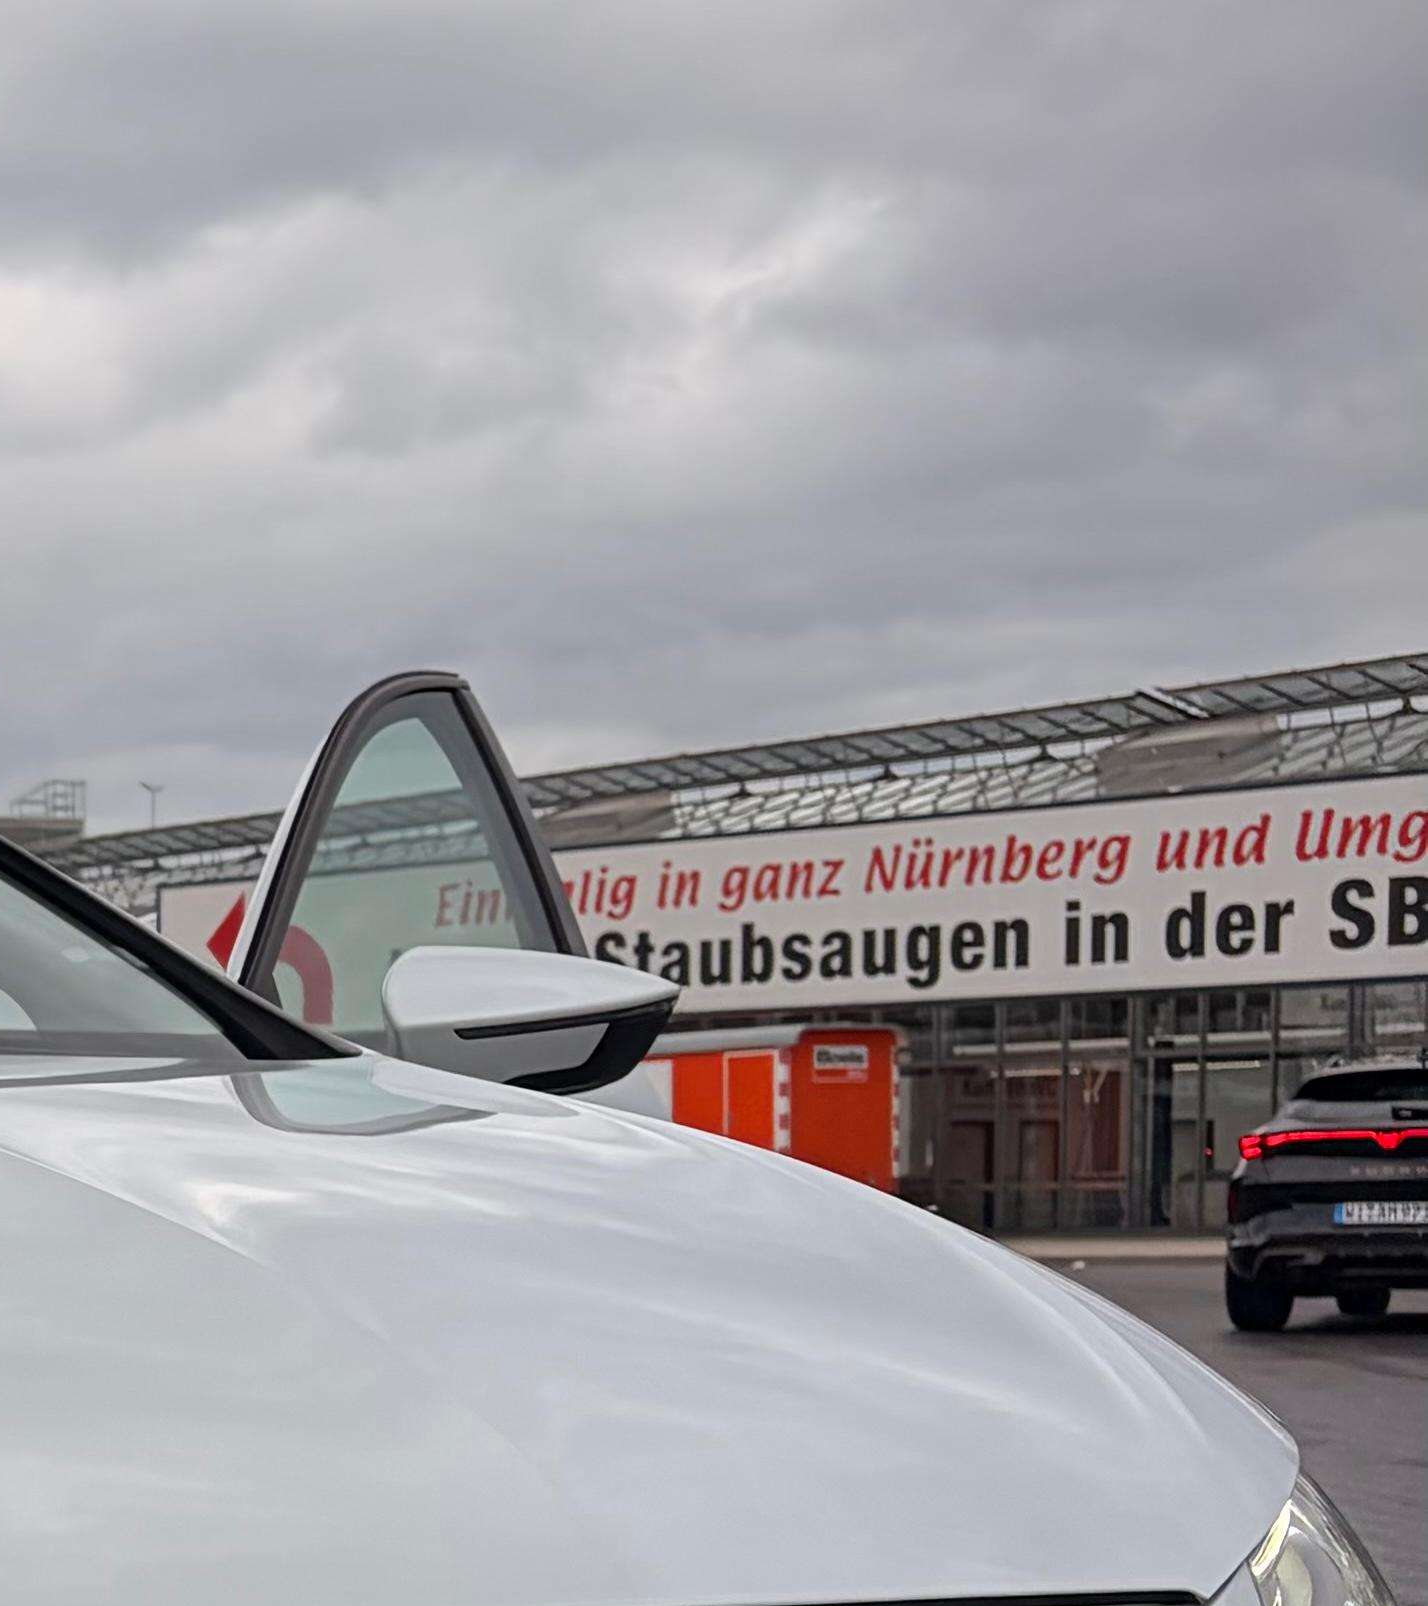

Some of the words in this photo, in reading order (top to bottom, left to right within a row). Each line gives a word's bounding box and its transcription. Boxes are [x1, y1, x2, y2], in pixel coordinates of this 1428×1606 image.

[434, 866, 637, 929] Einlig
[657, 860, 700, 910] in
[717, 856, 846, 911] ganz
[863, 832, 1132, 894] Nürnberg
[1155, 813, 1272, 874] und
[595, 922, 1029, 989] Staubsaugen
[1064, 900, 1129, 966] in
[1165, 891, 1296, 960] der
